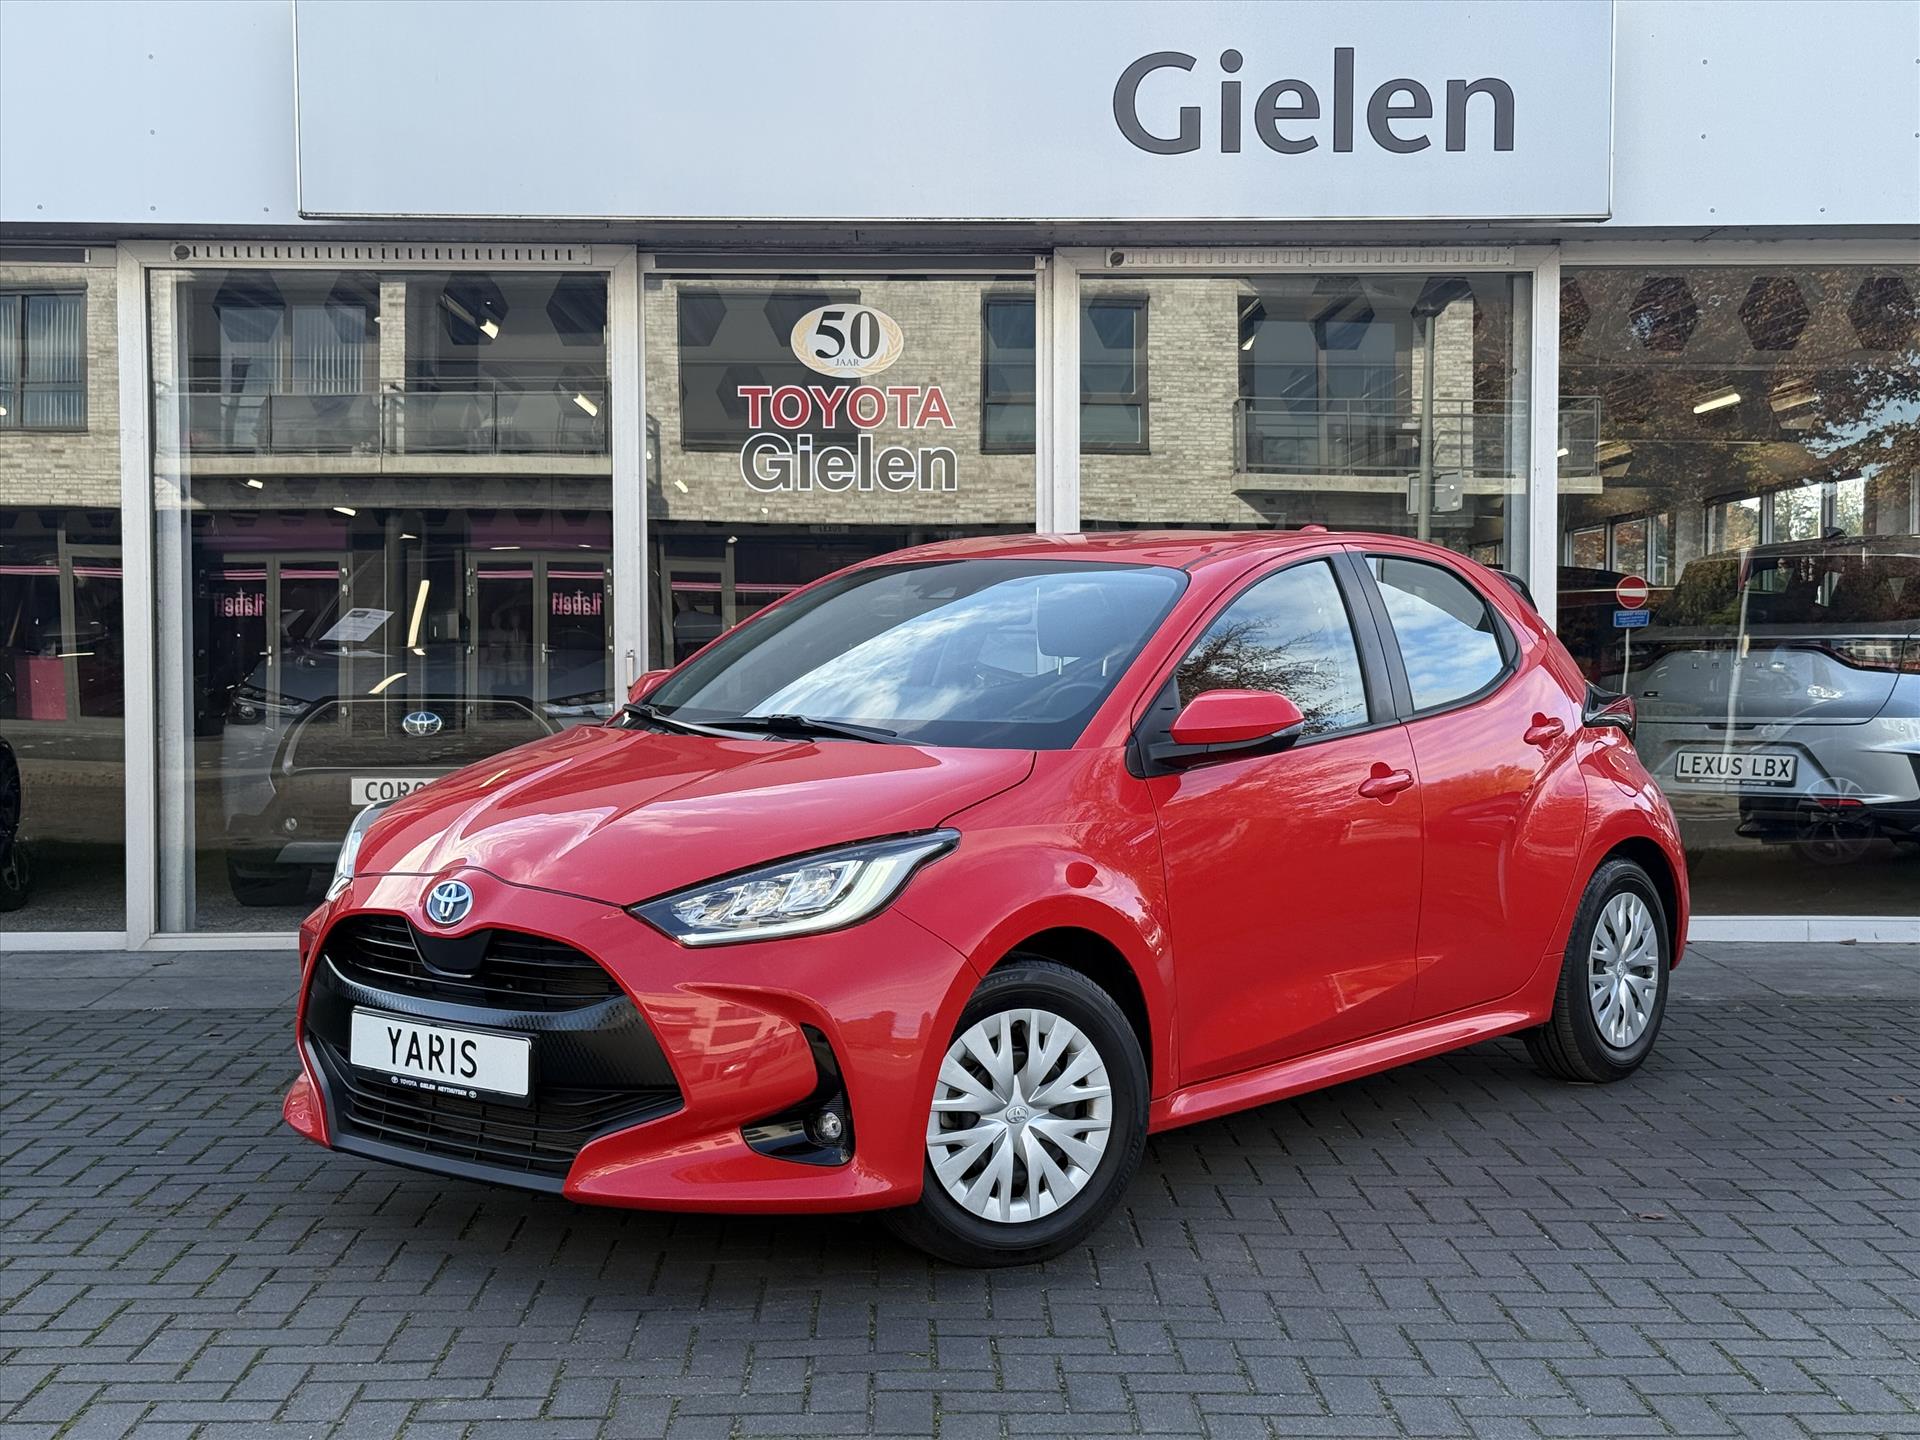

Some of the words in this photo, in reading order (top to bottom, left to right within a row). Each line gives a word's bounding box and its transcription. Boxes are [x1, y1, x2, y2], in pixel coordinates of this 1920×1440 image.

[1112, 47, 1515, 155] Gielen
[815, 310, 881, 359] 50
[835, 358, 860, 366] JAAR
[737, 385, 956, 430] TOYOTA
[740, 432, 958, 492] Gielen
[1680, 755, 1743, 776] LEXUS
[1752, 758, 1791, 778] LBX
[387, 1026, 478, 1079] YARIS
[400, 1078, 417, 1087] TOYOTA
